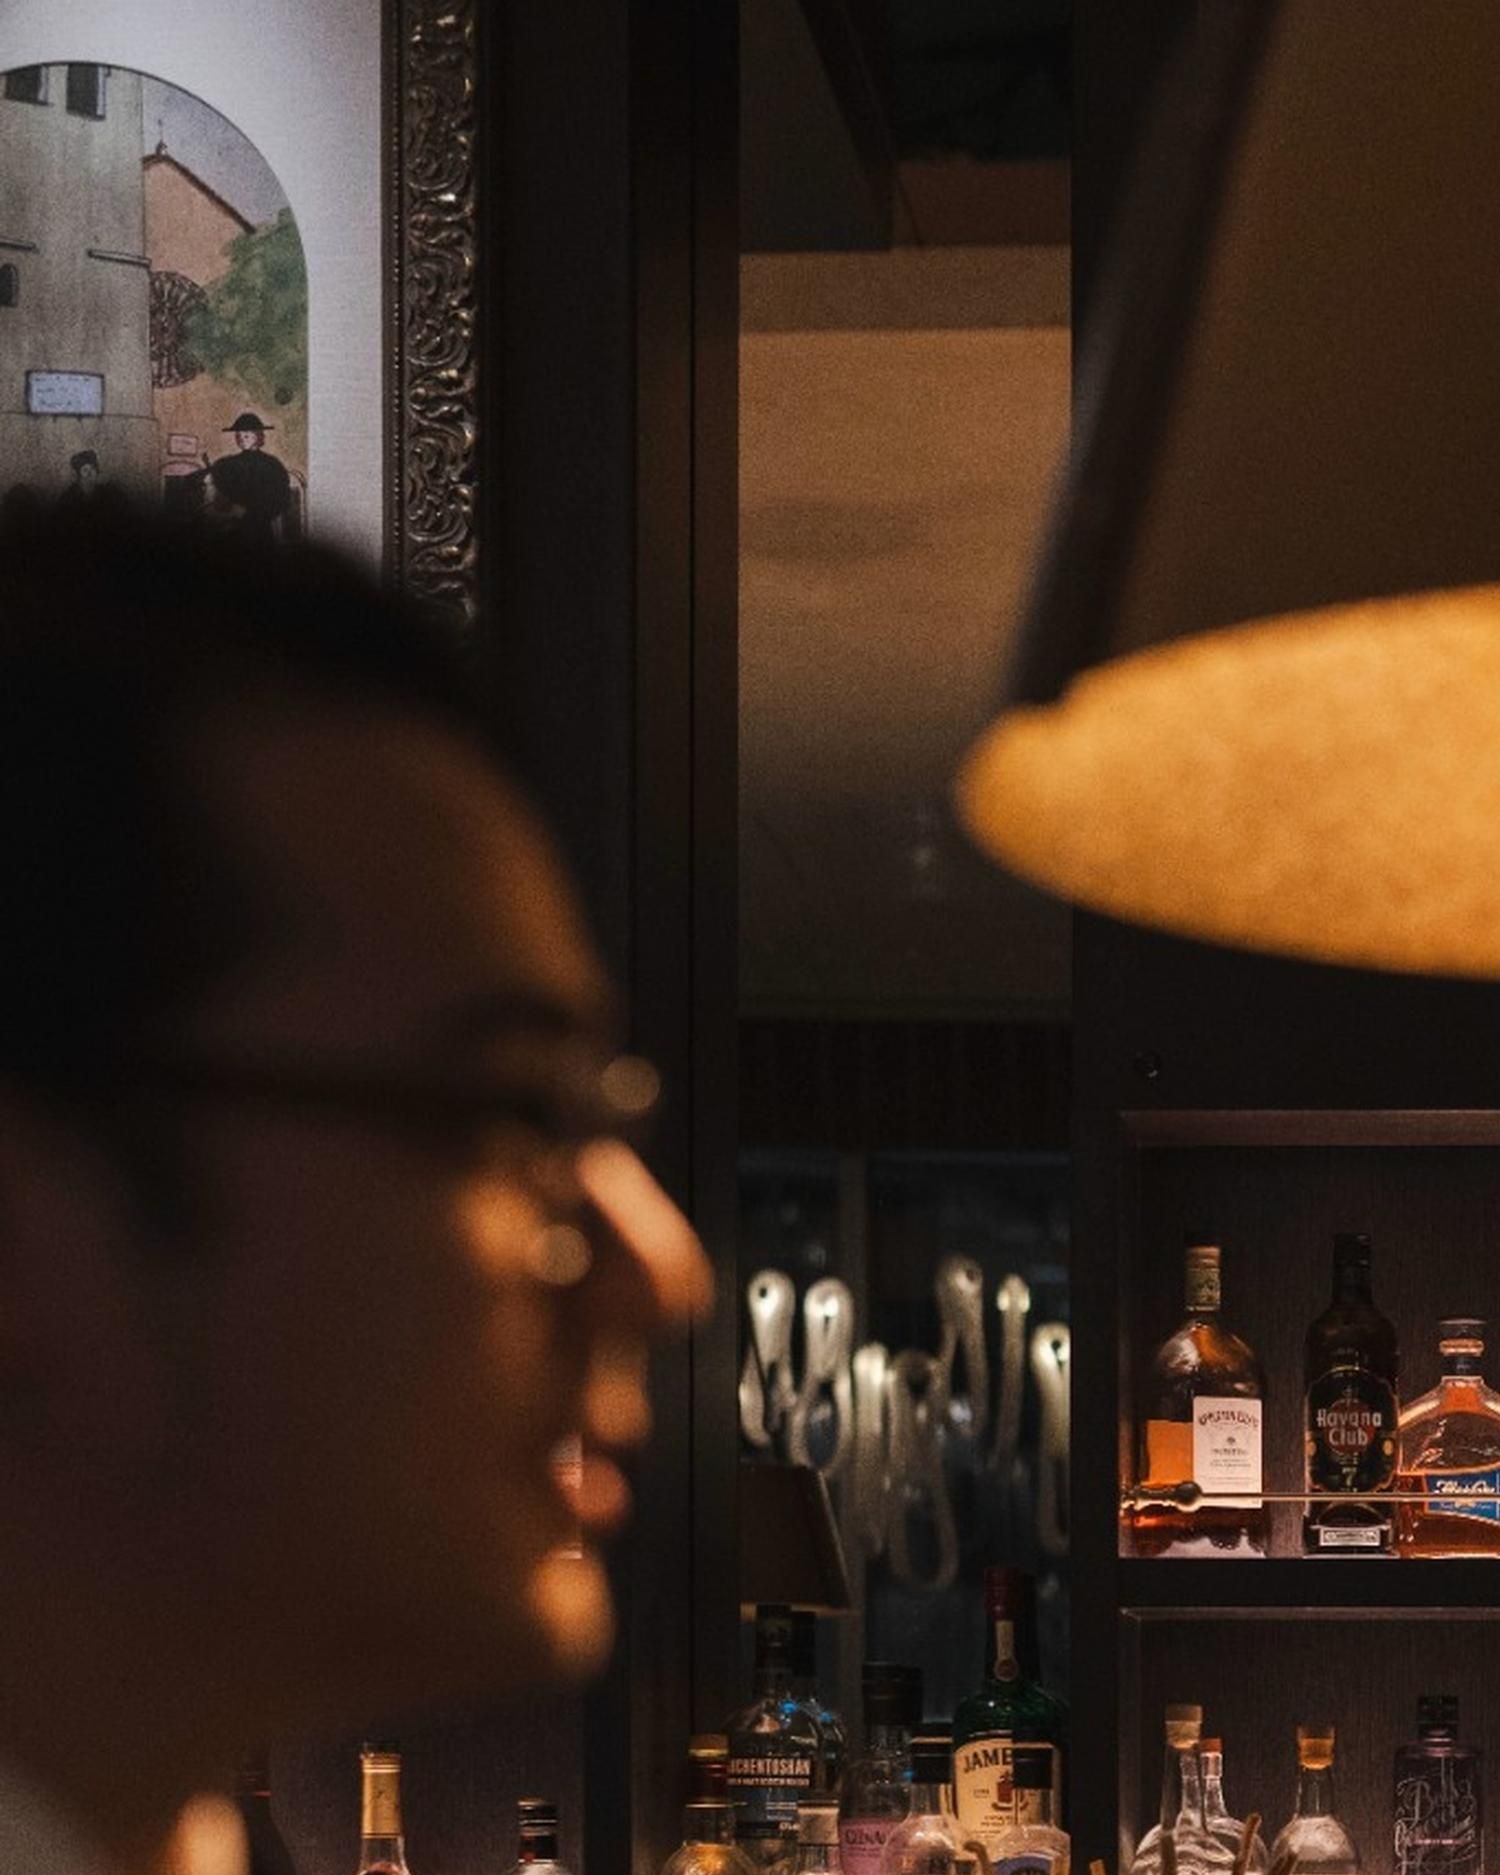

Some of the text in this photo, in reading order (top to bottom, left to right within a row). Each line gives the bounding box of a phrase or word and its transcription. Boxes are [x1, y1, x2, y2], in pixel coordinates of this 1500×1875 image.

[1316, 1408, 1382, 1428] Havana
[1328, 1427, 1369, 1446] Club
[1341, 1466, 1357, 1487] 7
